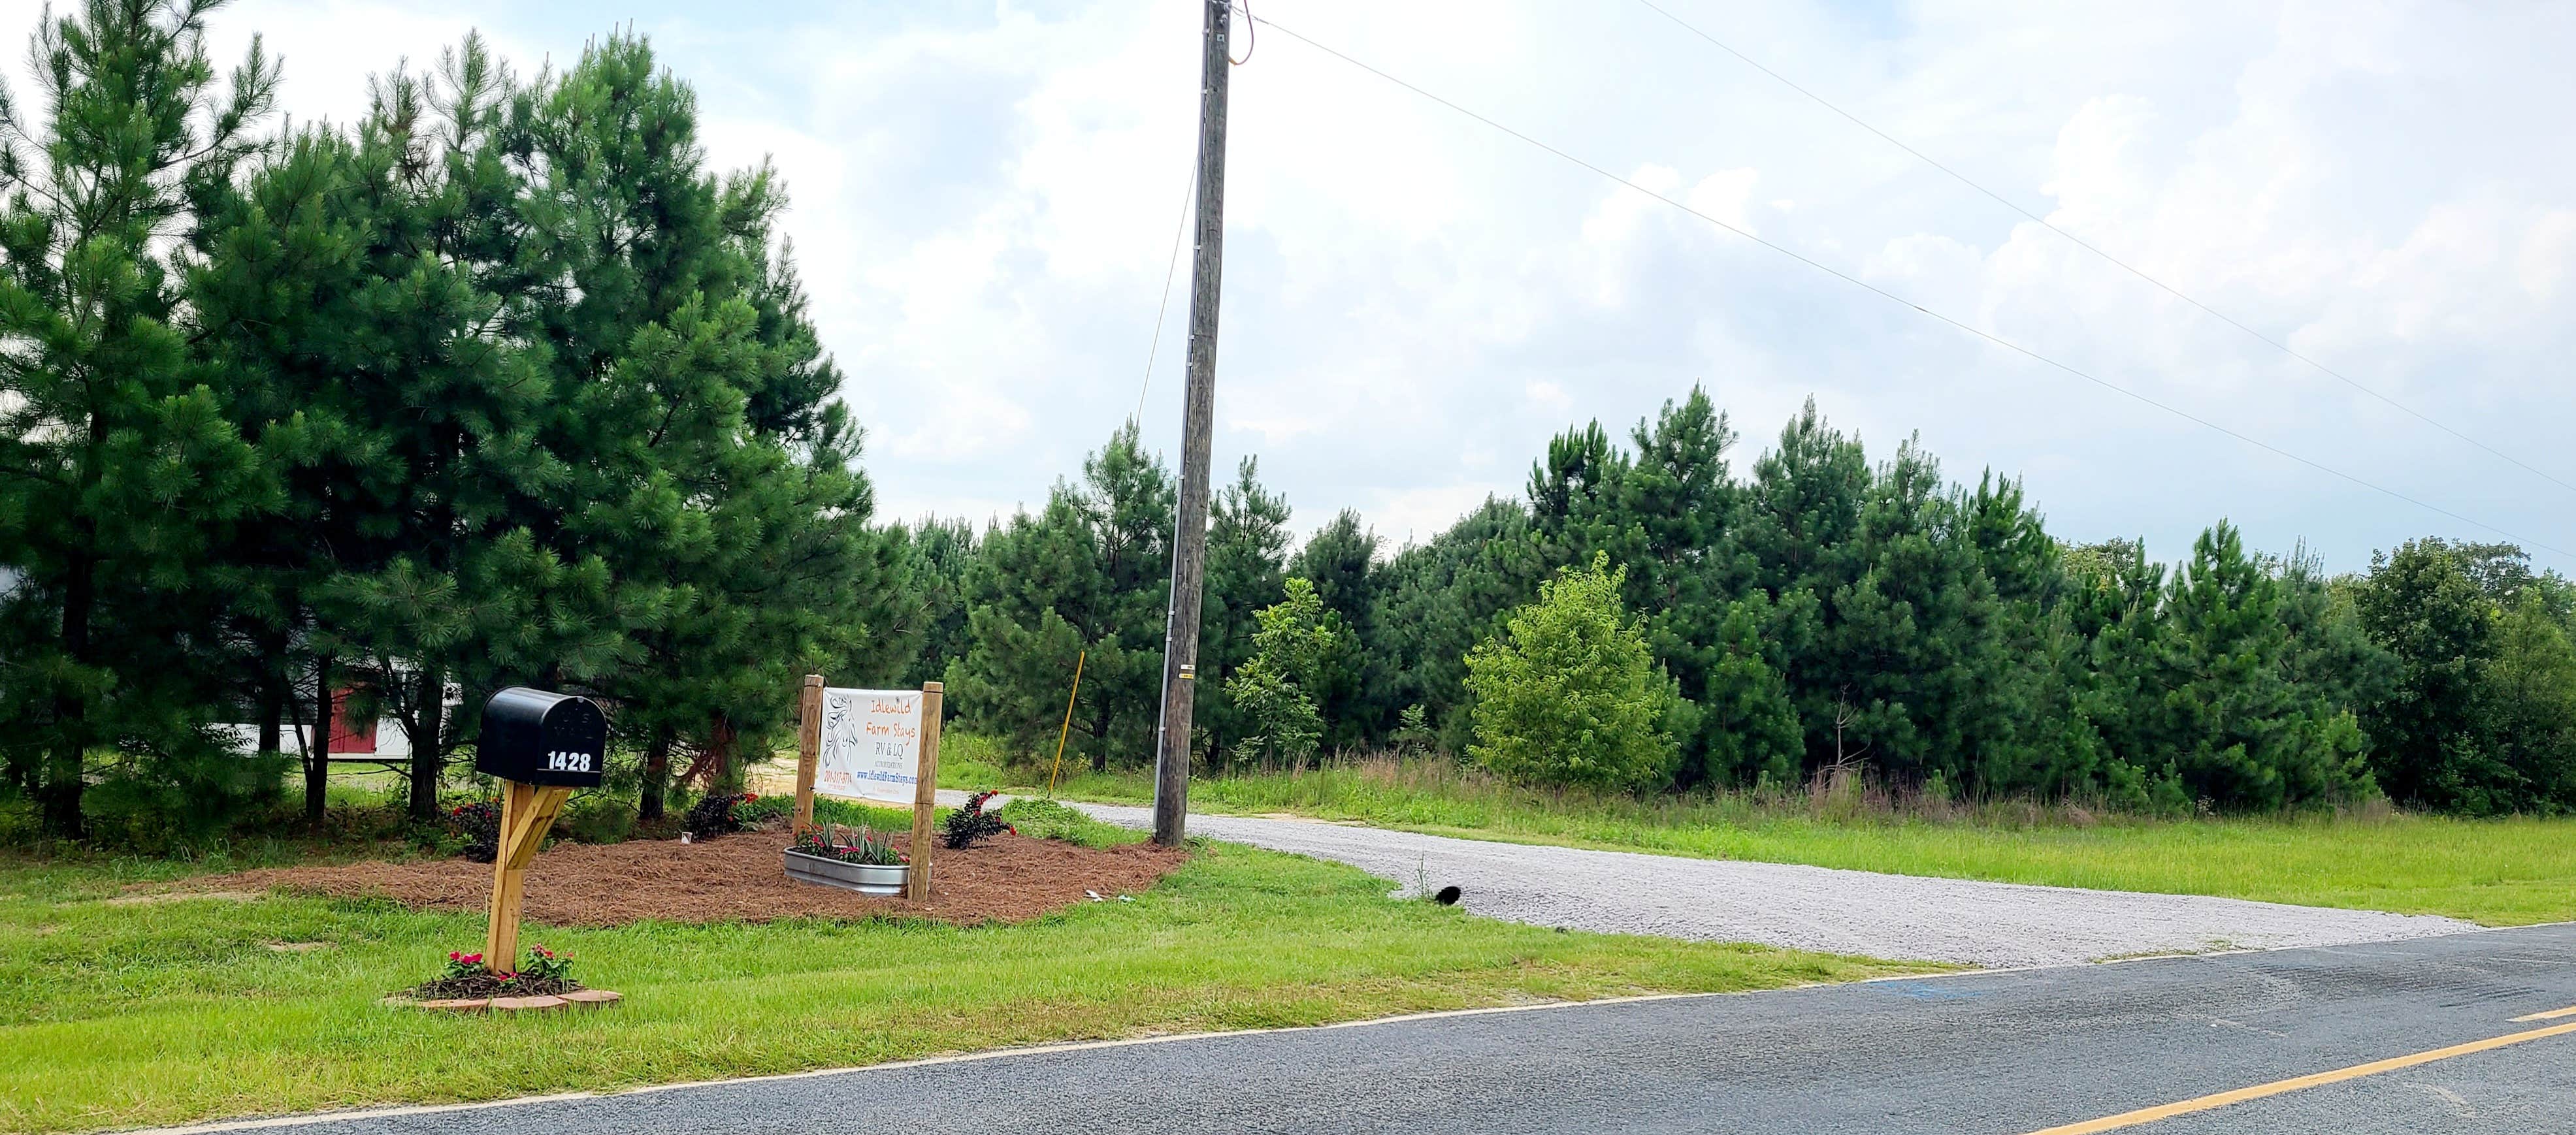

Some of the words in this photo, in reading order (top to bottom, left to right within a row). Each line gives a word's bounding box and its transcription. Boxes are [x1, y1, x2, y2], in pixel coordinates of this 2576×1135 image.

[871, 697, 911, 714] Idlewild
[866, 722, 889, 735] Farm
[894, 722, 915, 746] Stays
[875, 742, 886, 755] RV
[887, 743, 892, 756] &
[893, 743, 903, 759] LQ
[547, 750, 591, 772] 1428
